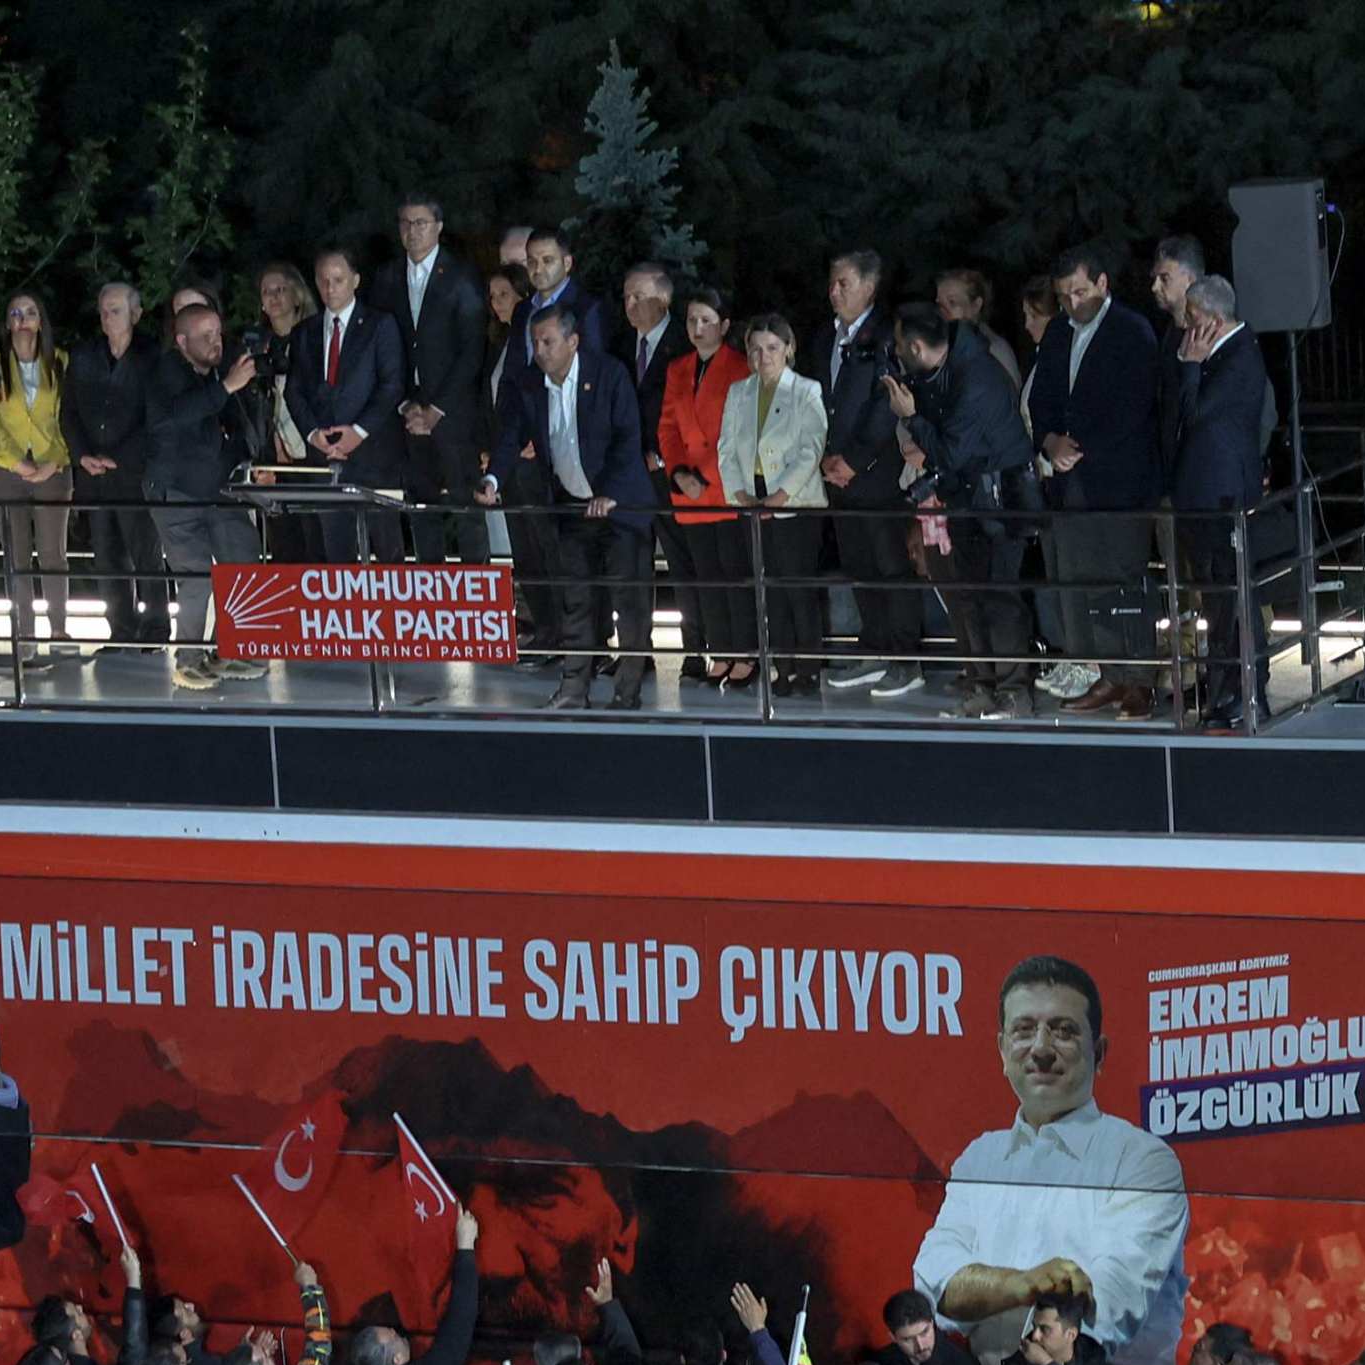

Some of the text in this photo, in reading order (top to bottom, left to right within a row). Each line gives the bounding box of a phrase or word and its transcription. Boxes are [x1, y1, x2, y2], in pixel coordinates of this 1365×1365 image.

[300, 570, 502, 602] CUMHURİYET
[300, 608, 510, 642] HALK PARTİSİ
[237, 640, 511, 659] TÜRKİYE'NİN BİRİNCİ PARTİSİ
[0, 922, 965, 1041] MİLLET İRADESİNE SAHİP ÇIKIYOR
[1148, 953, 1290, 983] CUMHURBAŞKANI ADAYIMIZ
[1148, 974, 1290, 1033] EKREM
[1148, 1071, 1361, 1137] ÖZGÜRLÜK
